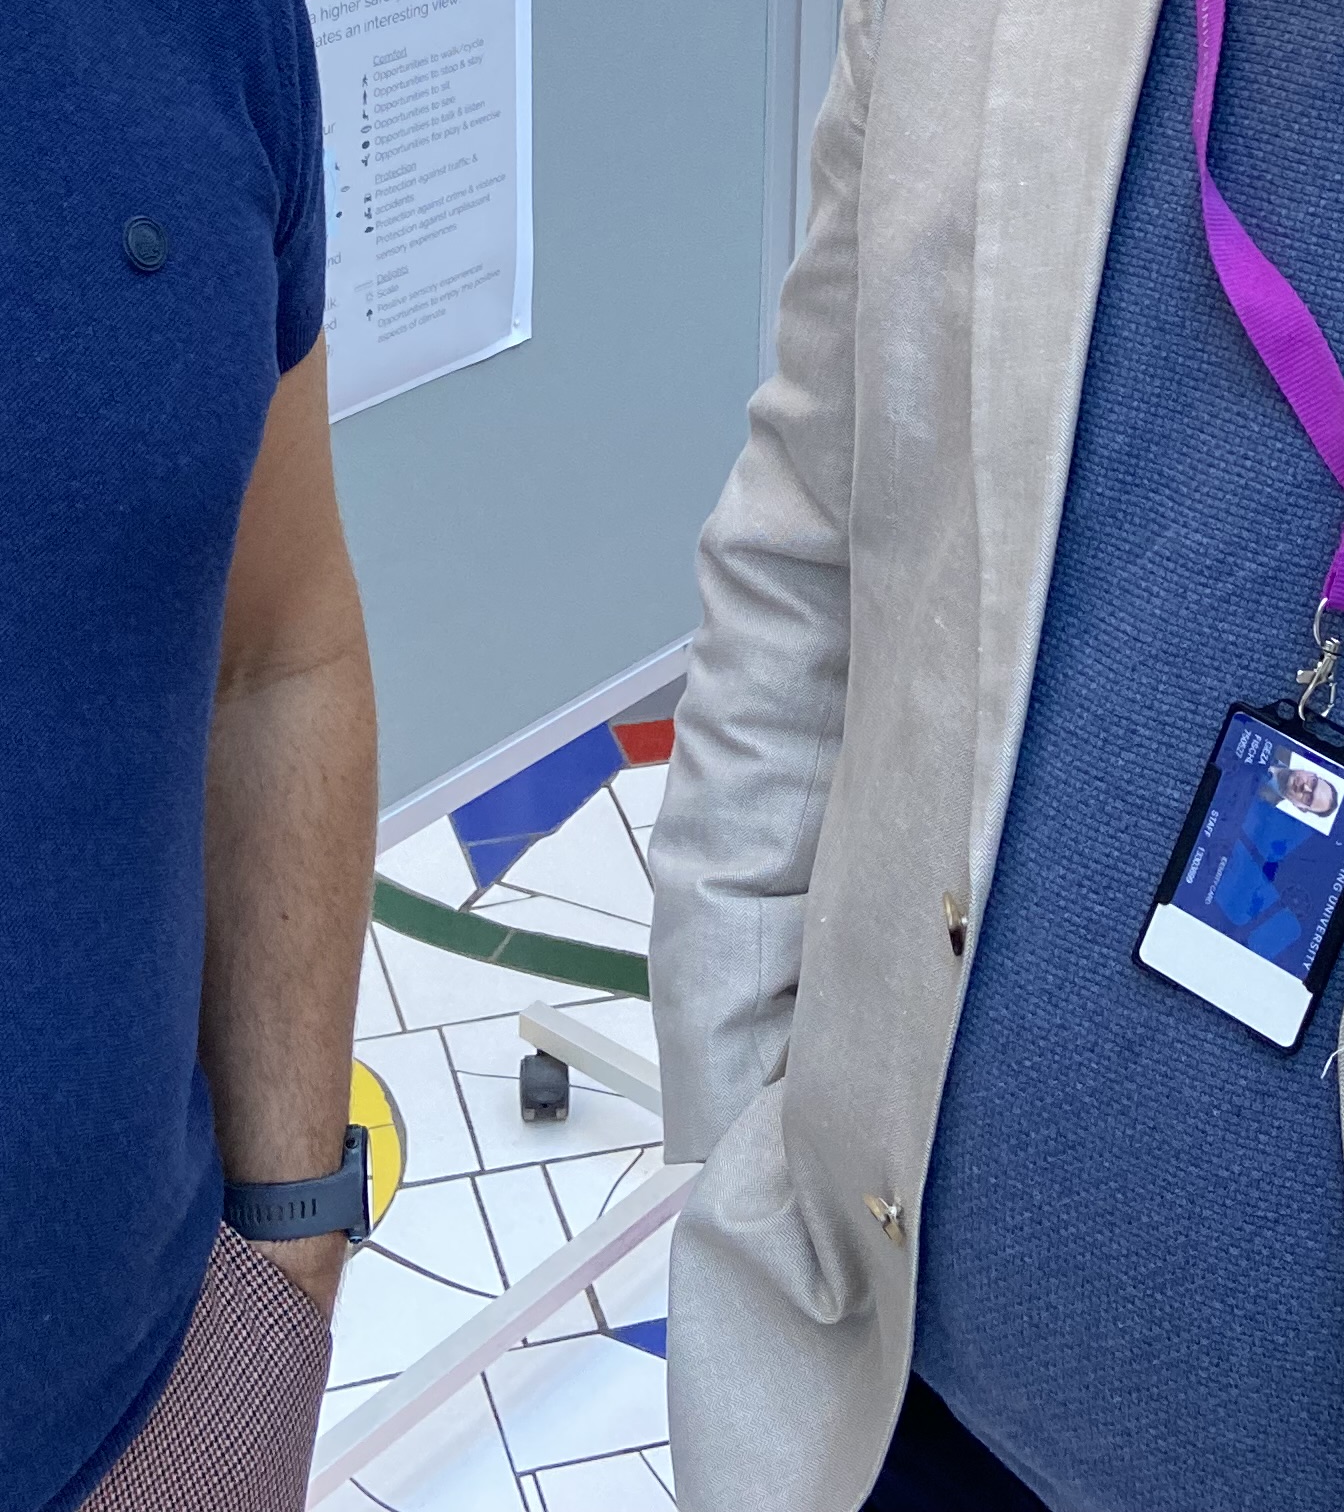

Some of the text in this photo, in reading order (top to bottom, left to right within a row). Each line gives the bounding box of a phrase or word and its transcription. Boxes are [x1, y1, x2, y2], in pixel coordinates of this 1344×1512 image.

[310, 11, 318, 26] a
[345, 22, 362, 37] an
[363, 2, 430, 34] interesting
[372, 46, 408, 68] Comfort
[373, 57, 430, 82] Opportunities
[430, 53, 439, 63] to
[373, 73, 430, 98] Opportunities
[431, 69, 440, 79] to
[374, 88, 430, 113] Opportunities
[431, 85, 440, 95] to
[374, 104, 430, 129] Opportunities
[431, 101, 441, 111] to
[374, 162, 418, 186] Protection
[1203, 808, 1220, 839] STAFF
[1301, 892, 1342, 971] UNIVERSITY
